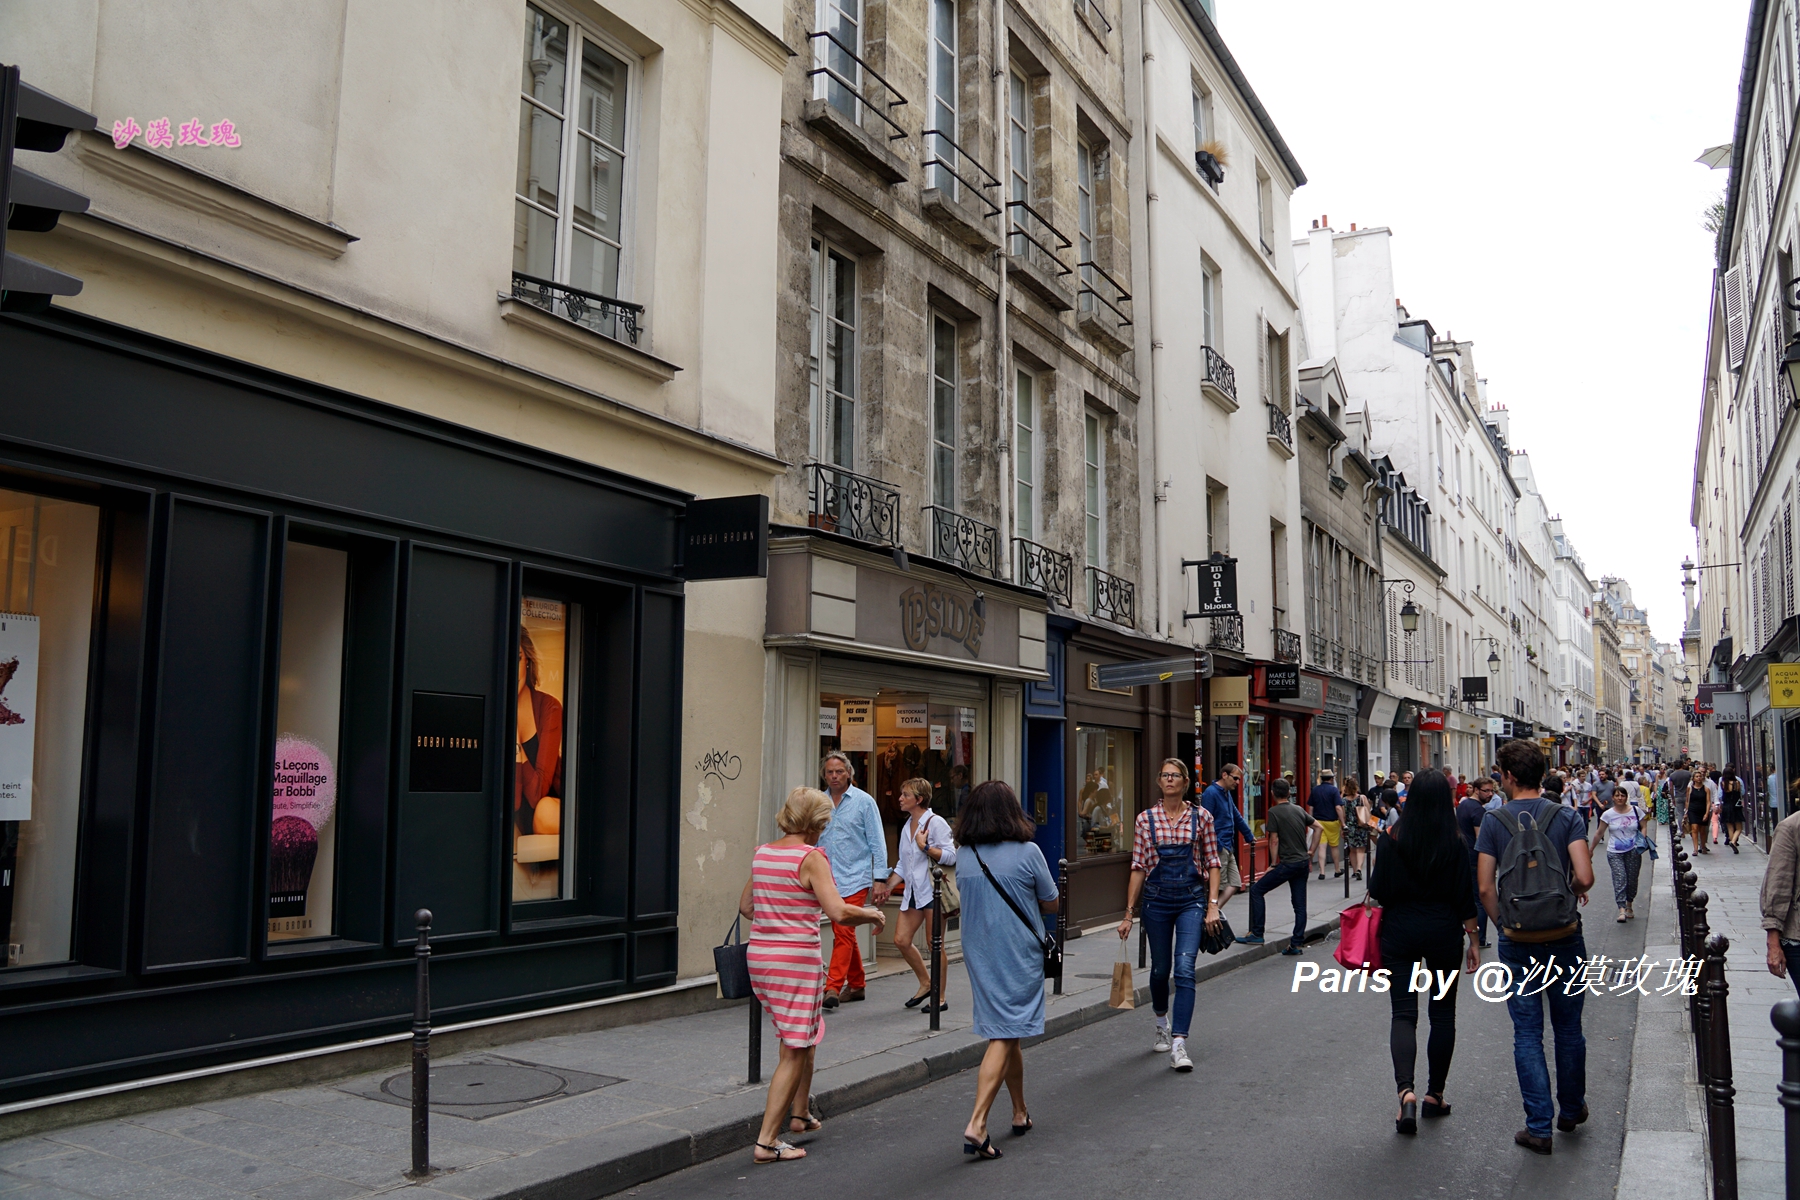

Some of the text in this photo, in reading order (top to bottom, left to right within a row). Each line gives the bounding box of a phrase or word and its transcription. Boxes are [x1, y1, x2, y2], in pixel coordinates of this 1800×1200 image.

[690, 530, 754, 546] BOBBI BROWN
[526, 600, 559, 612] TELLURIDE
[1203, 602, 1232, 610] bijoux
[521, 608, 562, 621] COLLECTION
[899, 583, 986, 659] UPSIDE
[1287, 671, 1296, 679] UP
[900, 716, 923, 724] TOTAL
[1716, 712, 1746, 721] Pablo
[820, 722, 834, 730] TOTAL
[962, 720, 974, 728] TOTAL
[417, 735, 478, 749] BOBBI BROWN
[283, 759, 320, 773] Leçons
[2, 782, 22, 790] teint
[273, 786, 316, 797] ar Bobbi
